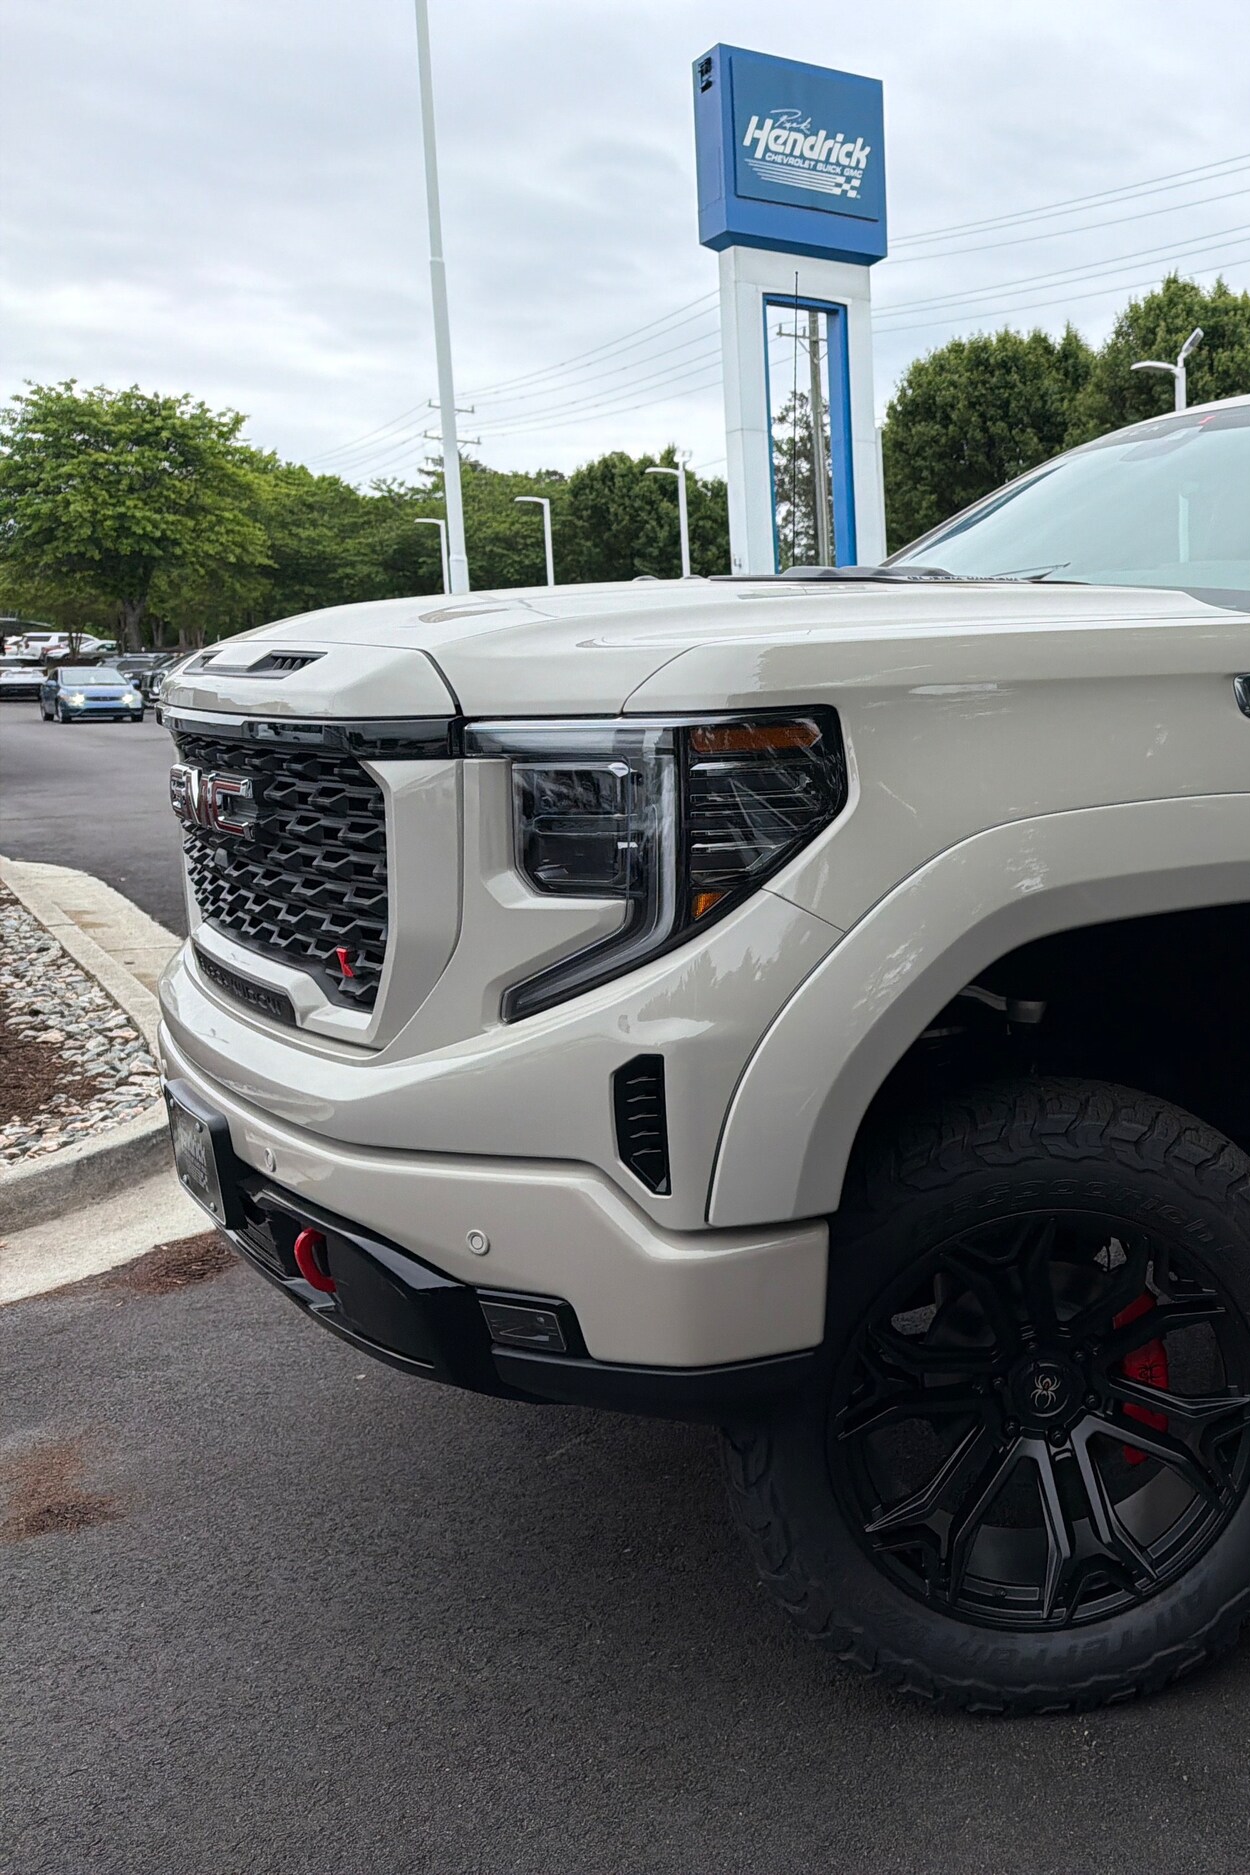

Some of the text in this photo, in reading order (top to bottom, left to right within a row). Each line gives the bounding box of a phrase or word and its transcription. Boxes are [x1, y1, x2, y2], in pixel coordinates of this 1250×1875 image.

[742, 115, 872, 170] Hendrick
[765, 152, 863, 179] CHEVROLET BUICK GMC
